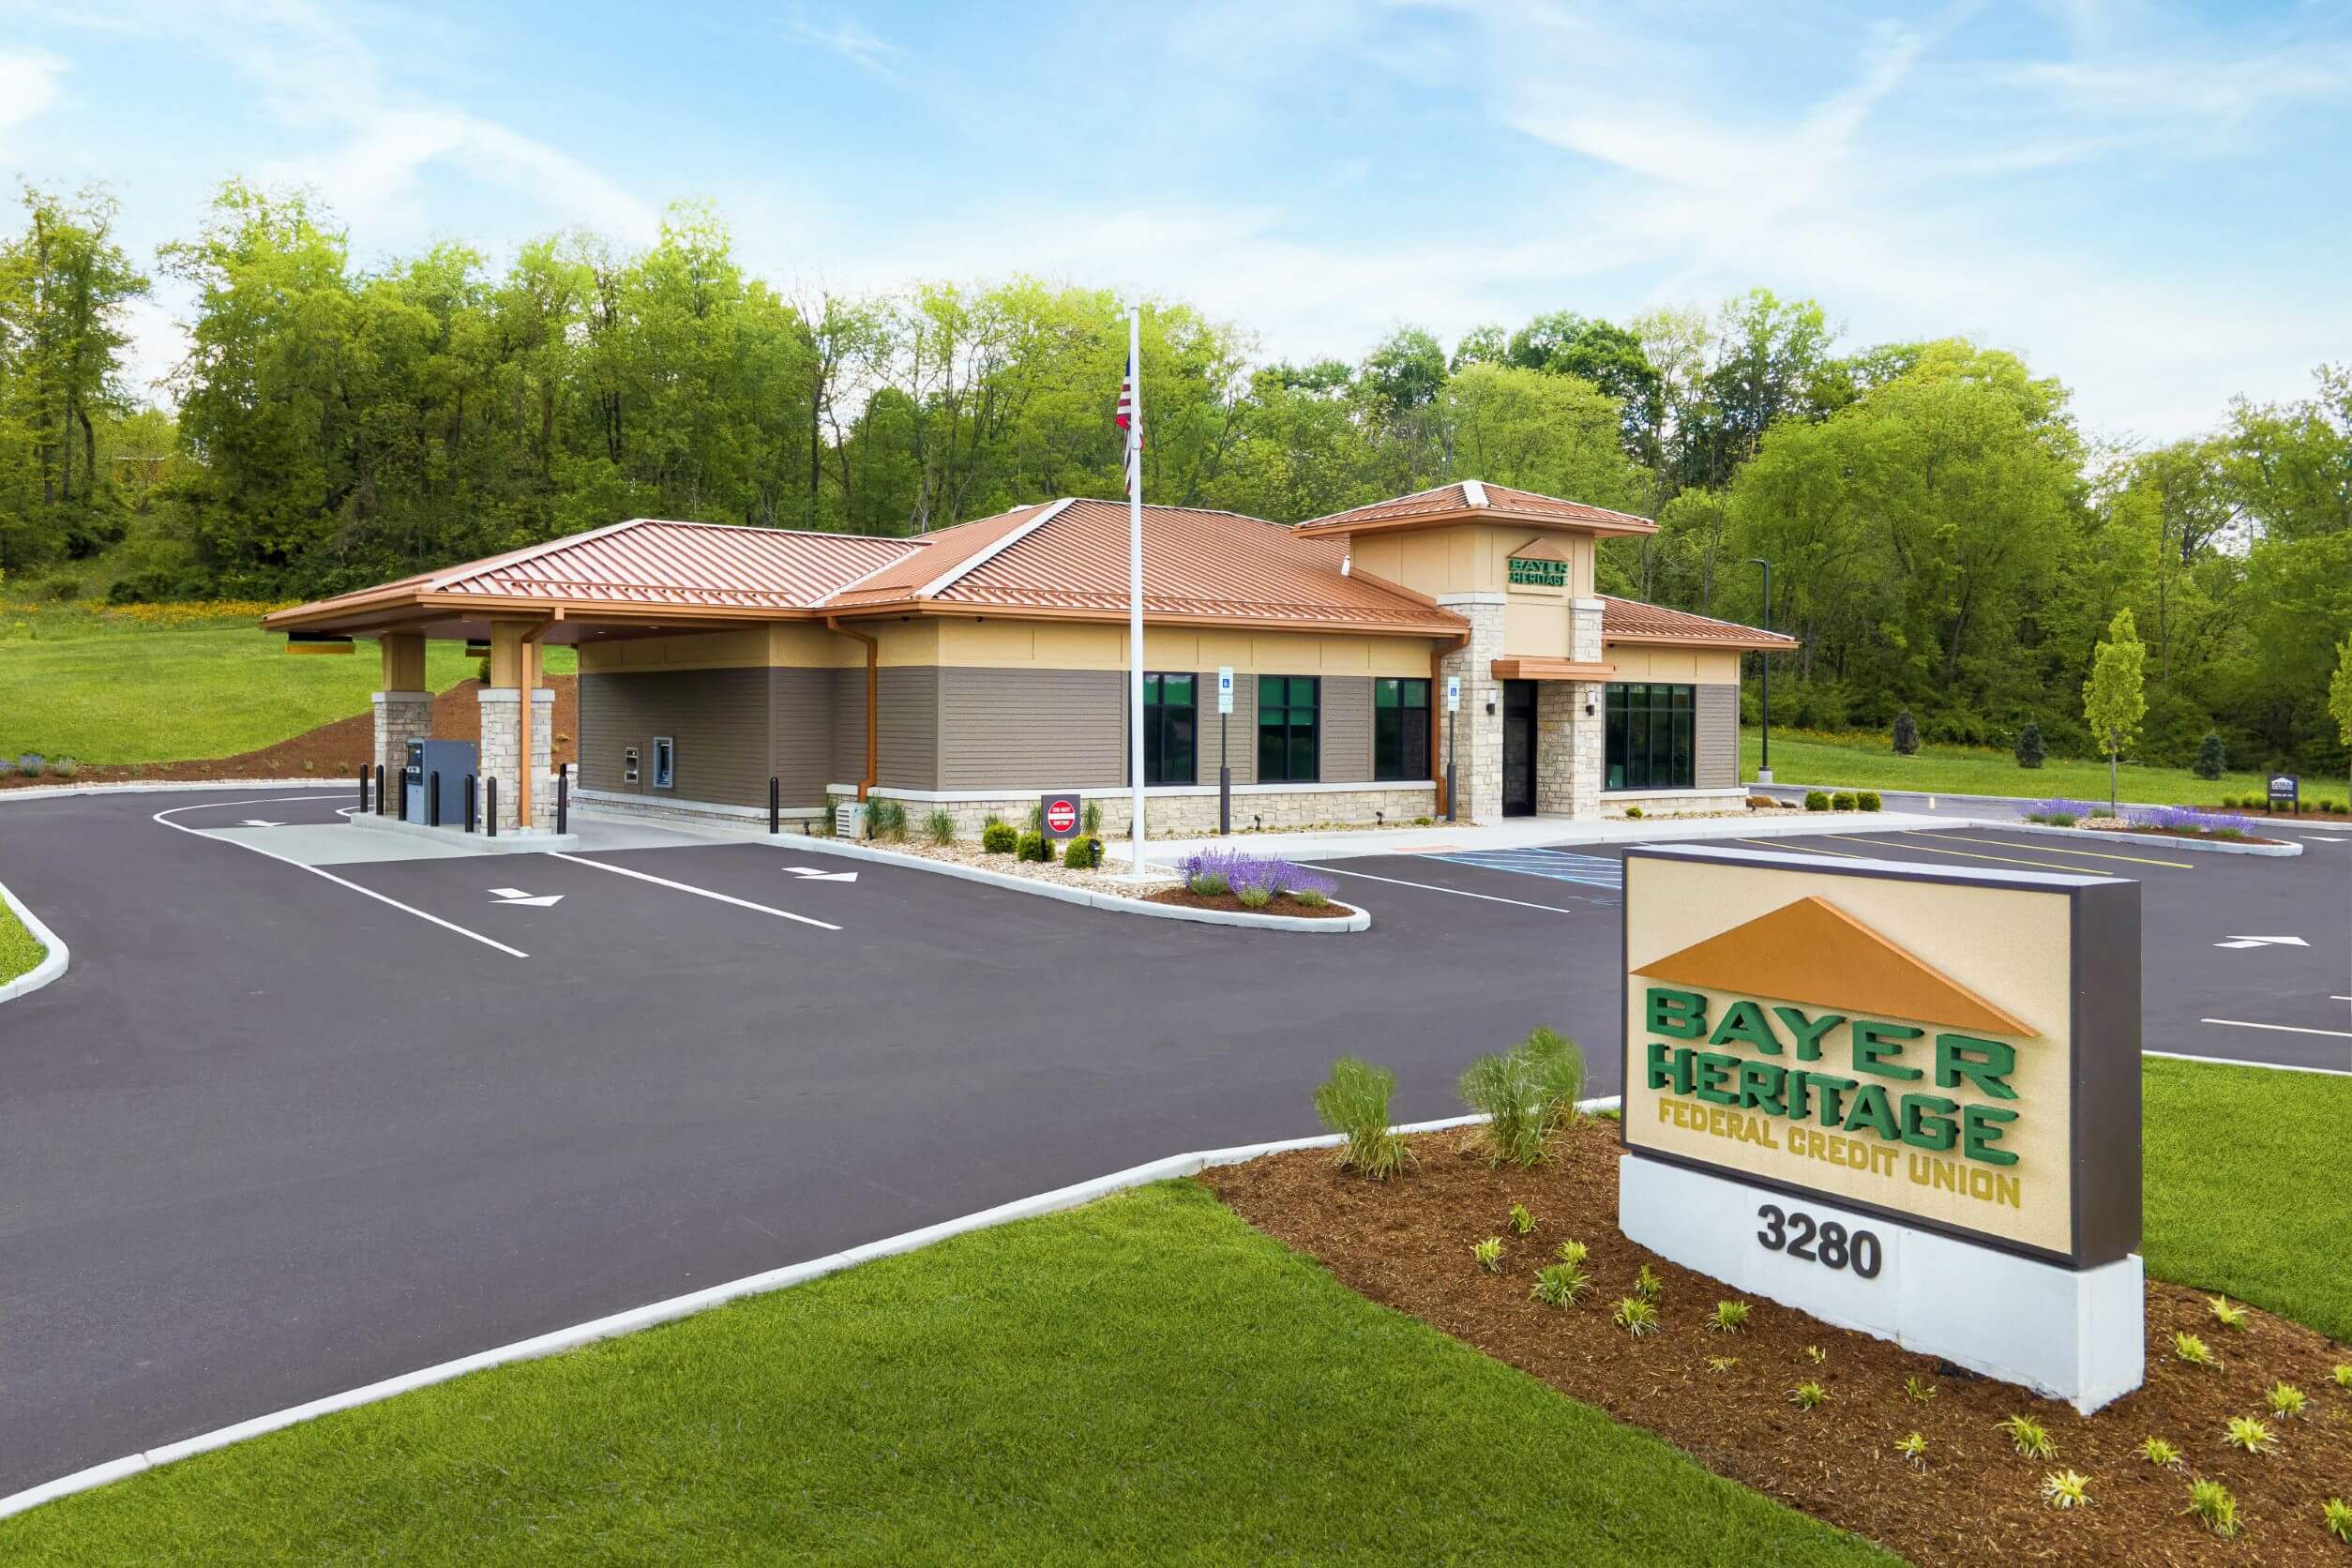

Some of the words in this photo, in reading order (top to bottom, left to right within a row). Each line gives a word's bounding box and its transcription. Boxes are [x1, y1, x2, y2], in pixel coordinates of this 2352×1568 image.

[1508, 559, 1570, 573] BAYER
[1508, 572, 1568, 586] HERITAGE
[1646, 987, 2019, 1100] BAYER
[1647, 1043, 2020, 1166] HERITAGE
[1658, 1097, 1778, 1149] FEDERAL
[1787, 1125, 1899, 1177] CREDIT
[1908, 1153, 2020, 1208] UNION
[1756, 1205, 1882, 1278] 3280
